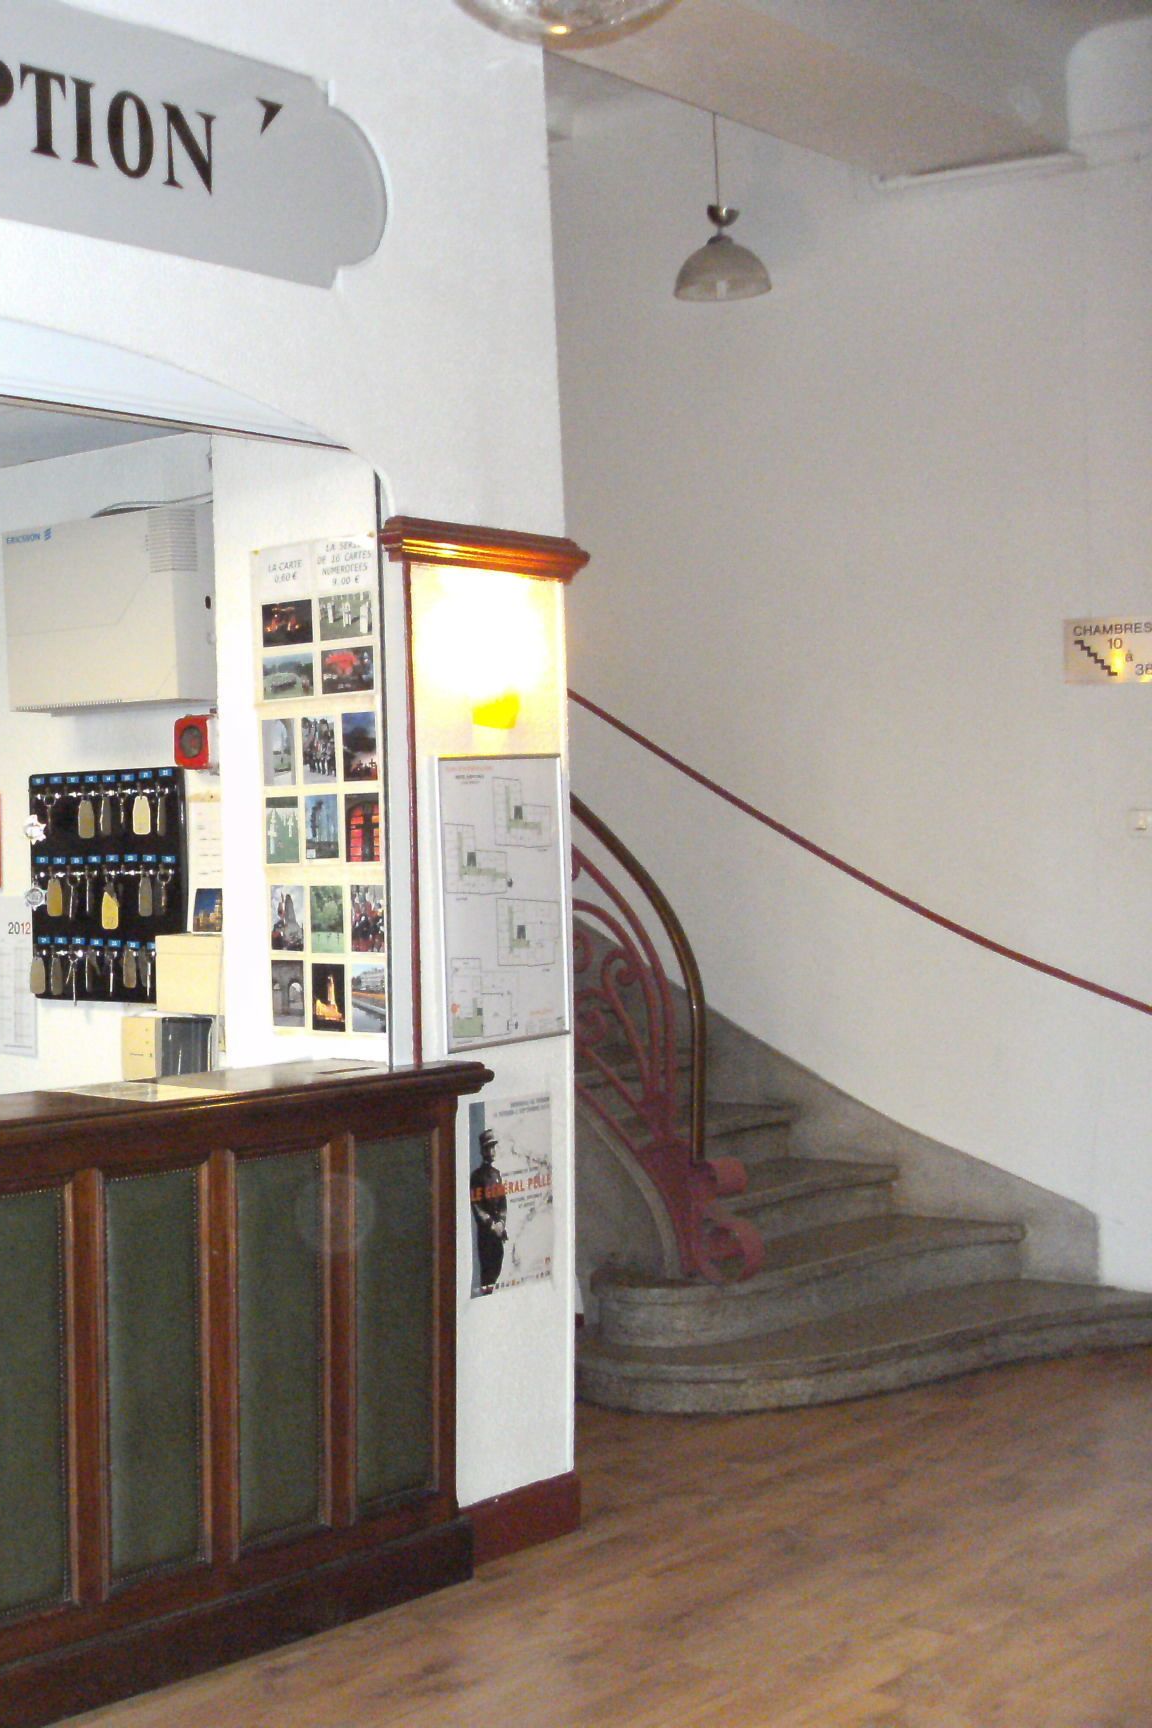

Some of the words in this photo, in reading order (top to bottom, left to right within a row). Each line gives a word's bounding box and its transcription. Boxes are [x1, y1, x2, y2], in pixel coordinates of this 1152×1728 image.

[1073, 621, 1152, 637] CHAMBRES
[1107, 638, 1123, 650] 10
[7, 921, 32, 935] 2012
